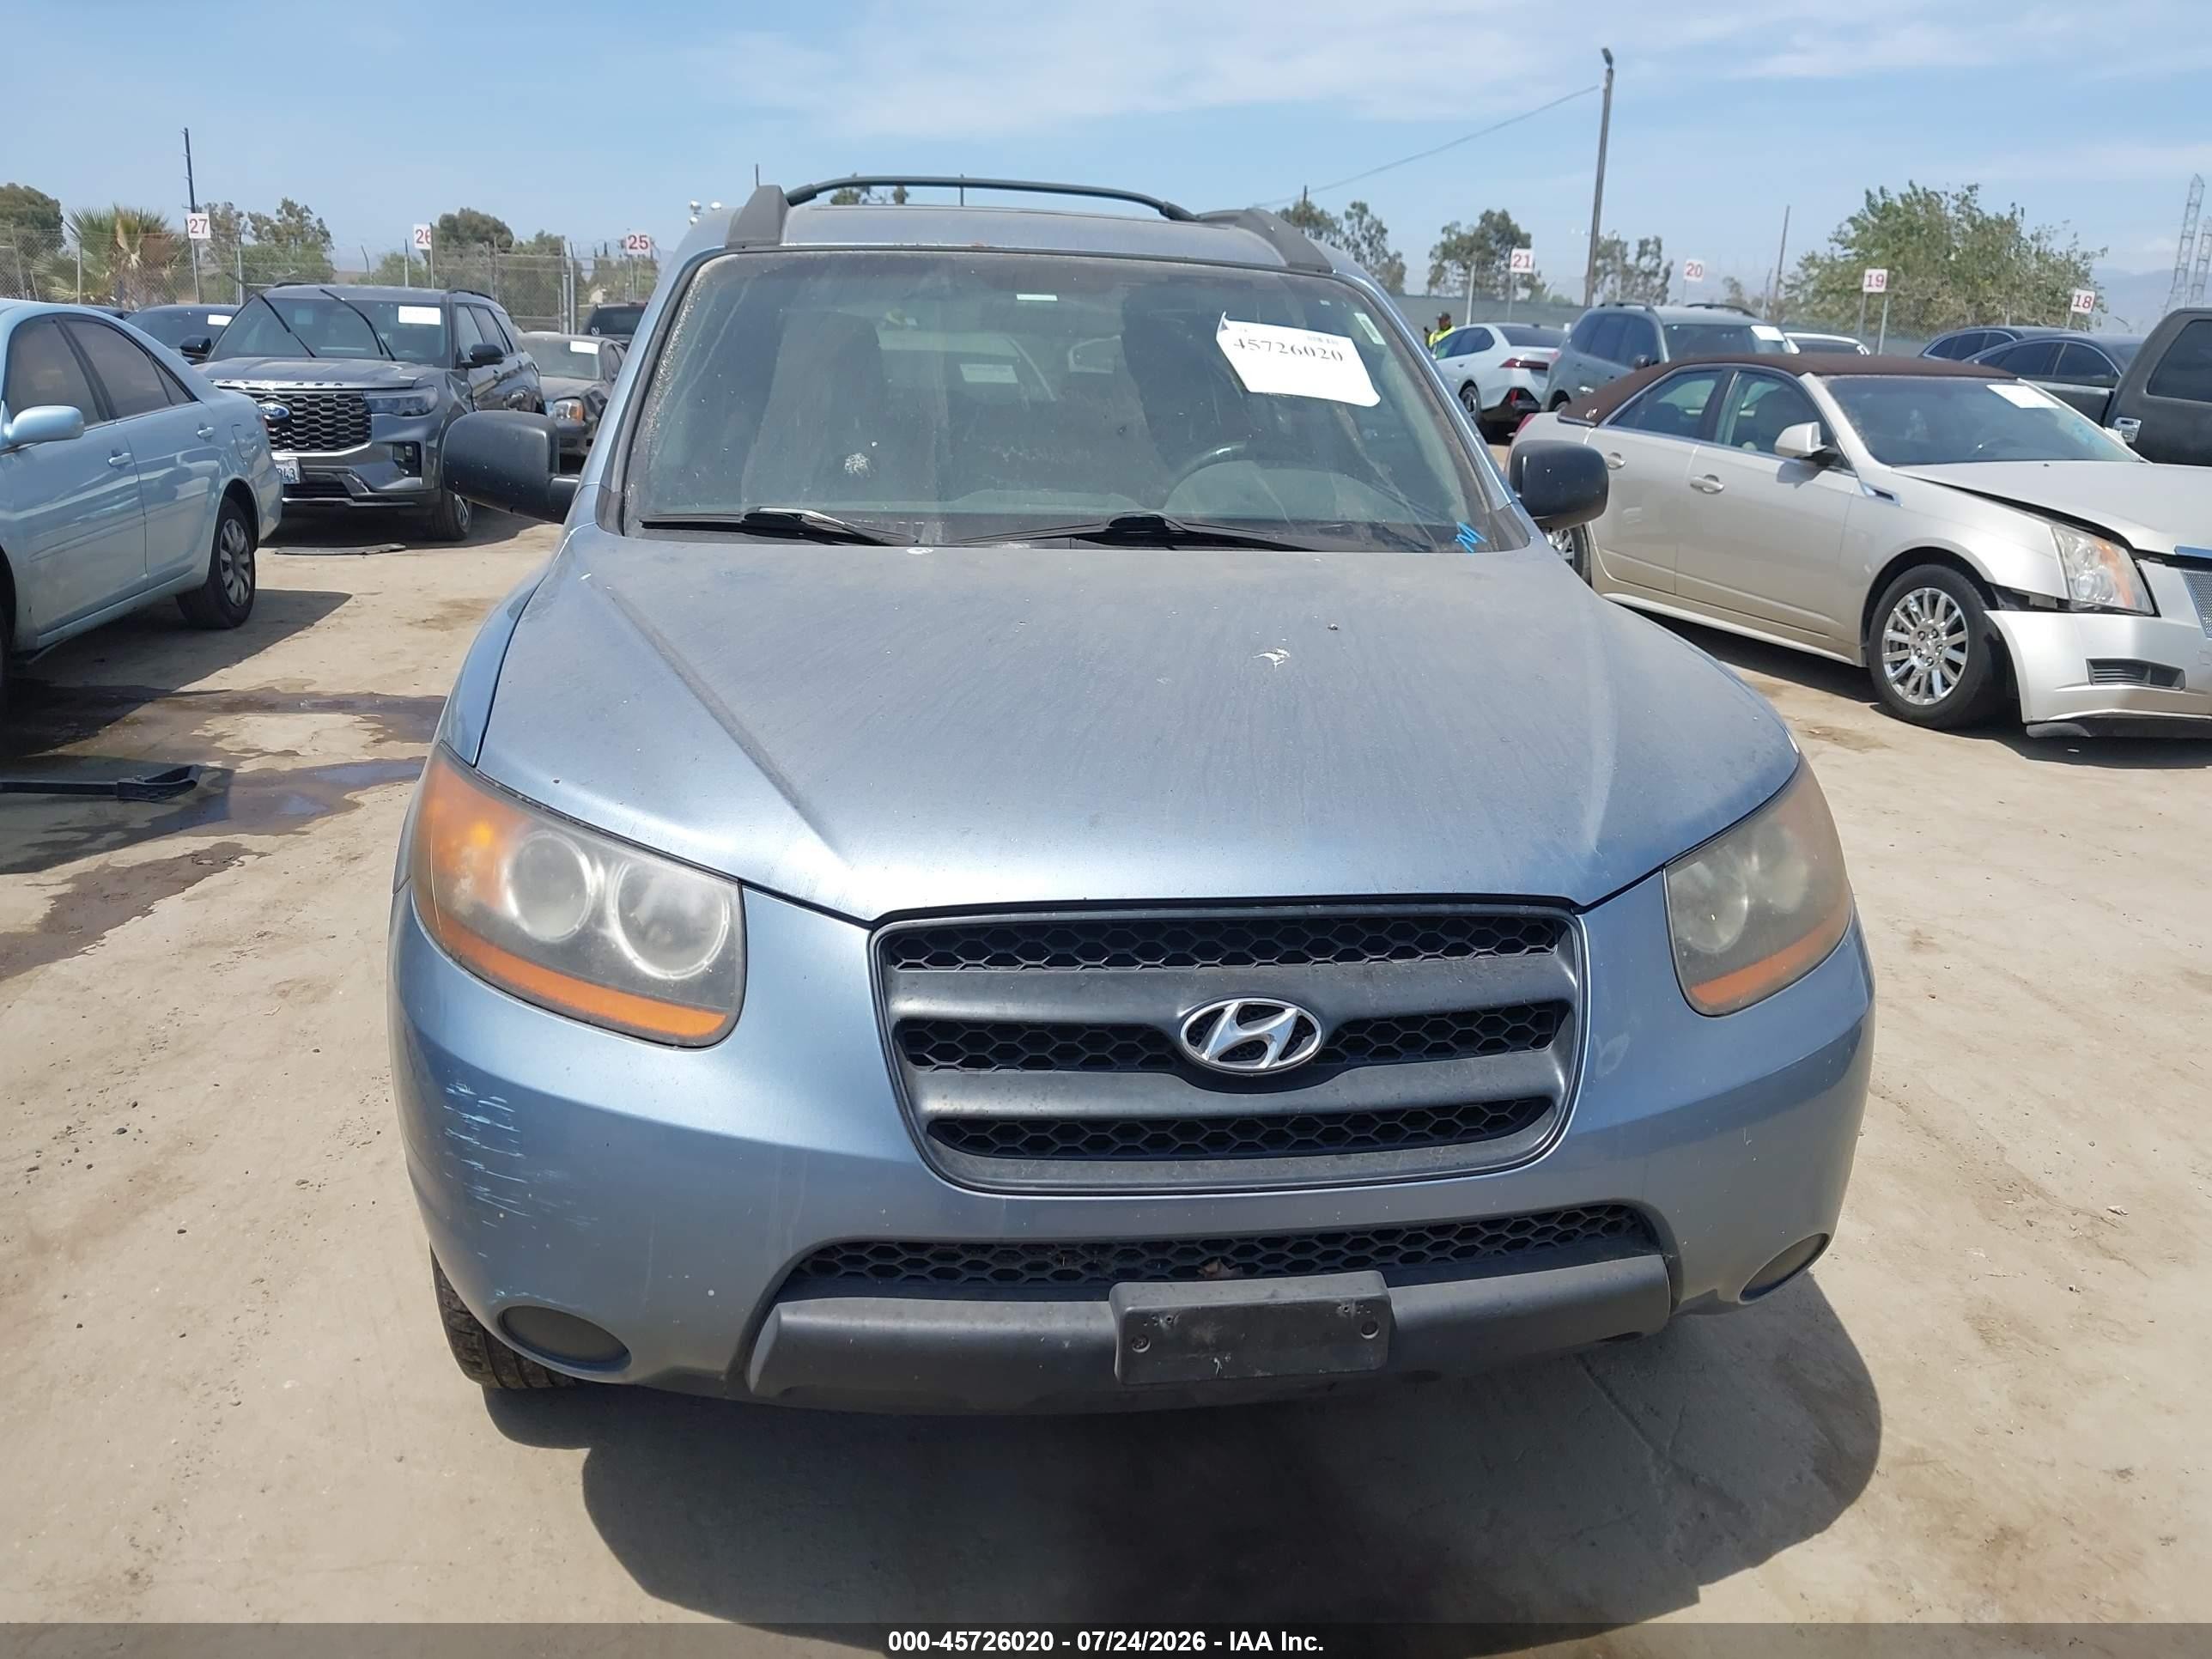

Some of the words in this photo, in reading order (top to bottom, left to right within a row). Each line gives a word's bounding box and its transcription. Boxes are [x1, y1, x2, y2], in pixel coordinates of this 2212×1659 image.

[189, 218, 208, 234] 27
[628, 234, 648, 250] 25
[1513, 254, 1530, 268] 21
[1686, 263, 1704, 277] 20
[1865, 274, 1884, 288] 19
[2074, 295, 2092, 308] 18
[1234, 337, 1344, 362] 45726020
